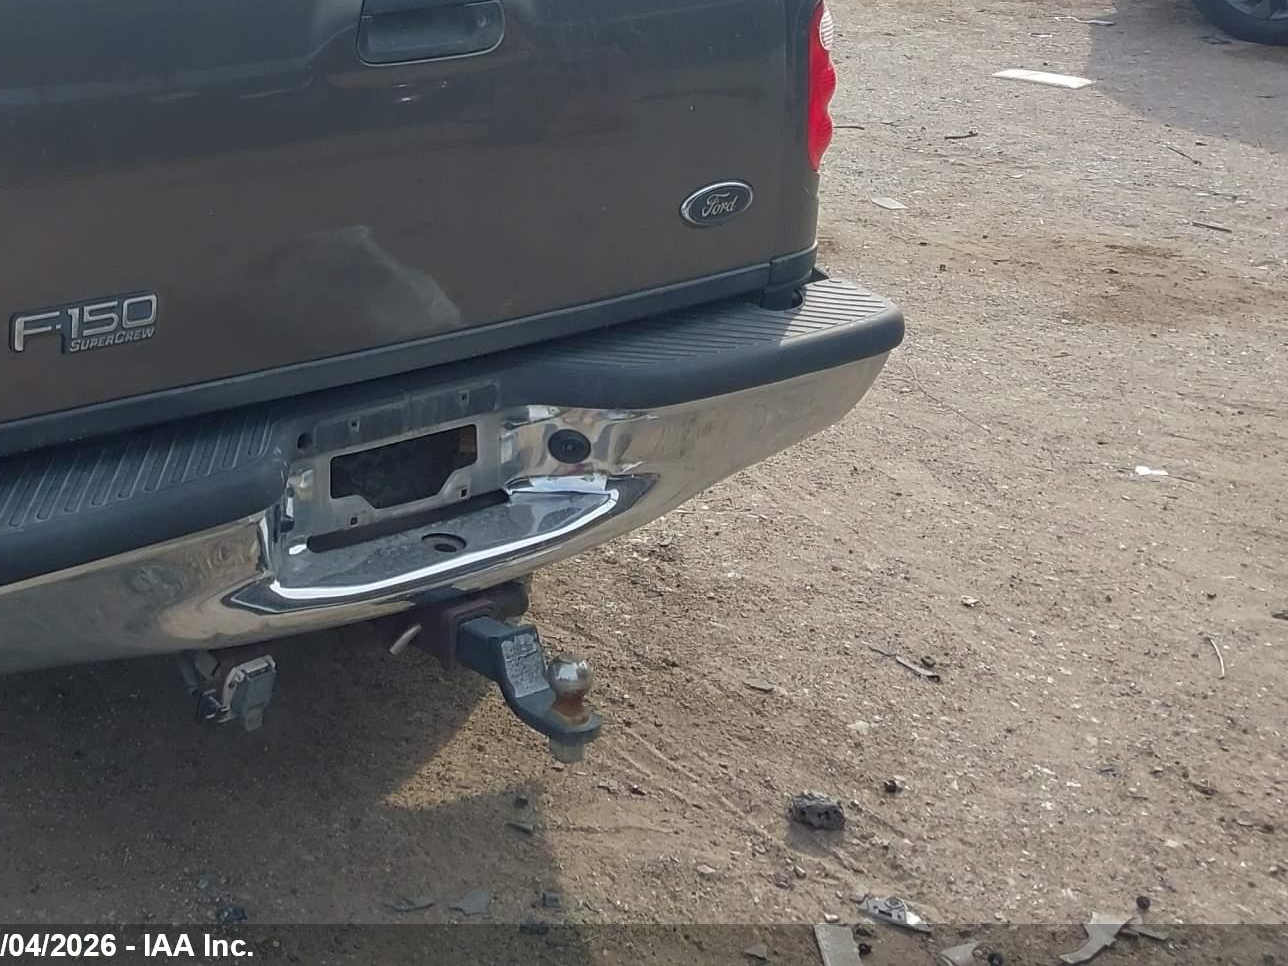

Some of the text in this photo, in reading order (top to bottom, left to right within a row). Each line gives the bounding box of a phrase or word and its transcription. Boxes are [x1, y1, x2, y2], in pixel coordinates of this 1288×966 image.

[701, 192, 737, 217] Ford
[14, 293, 157, 352] F-150
[69, 326, 156, 352] SUPERCREW
